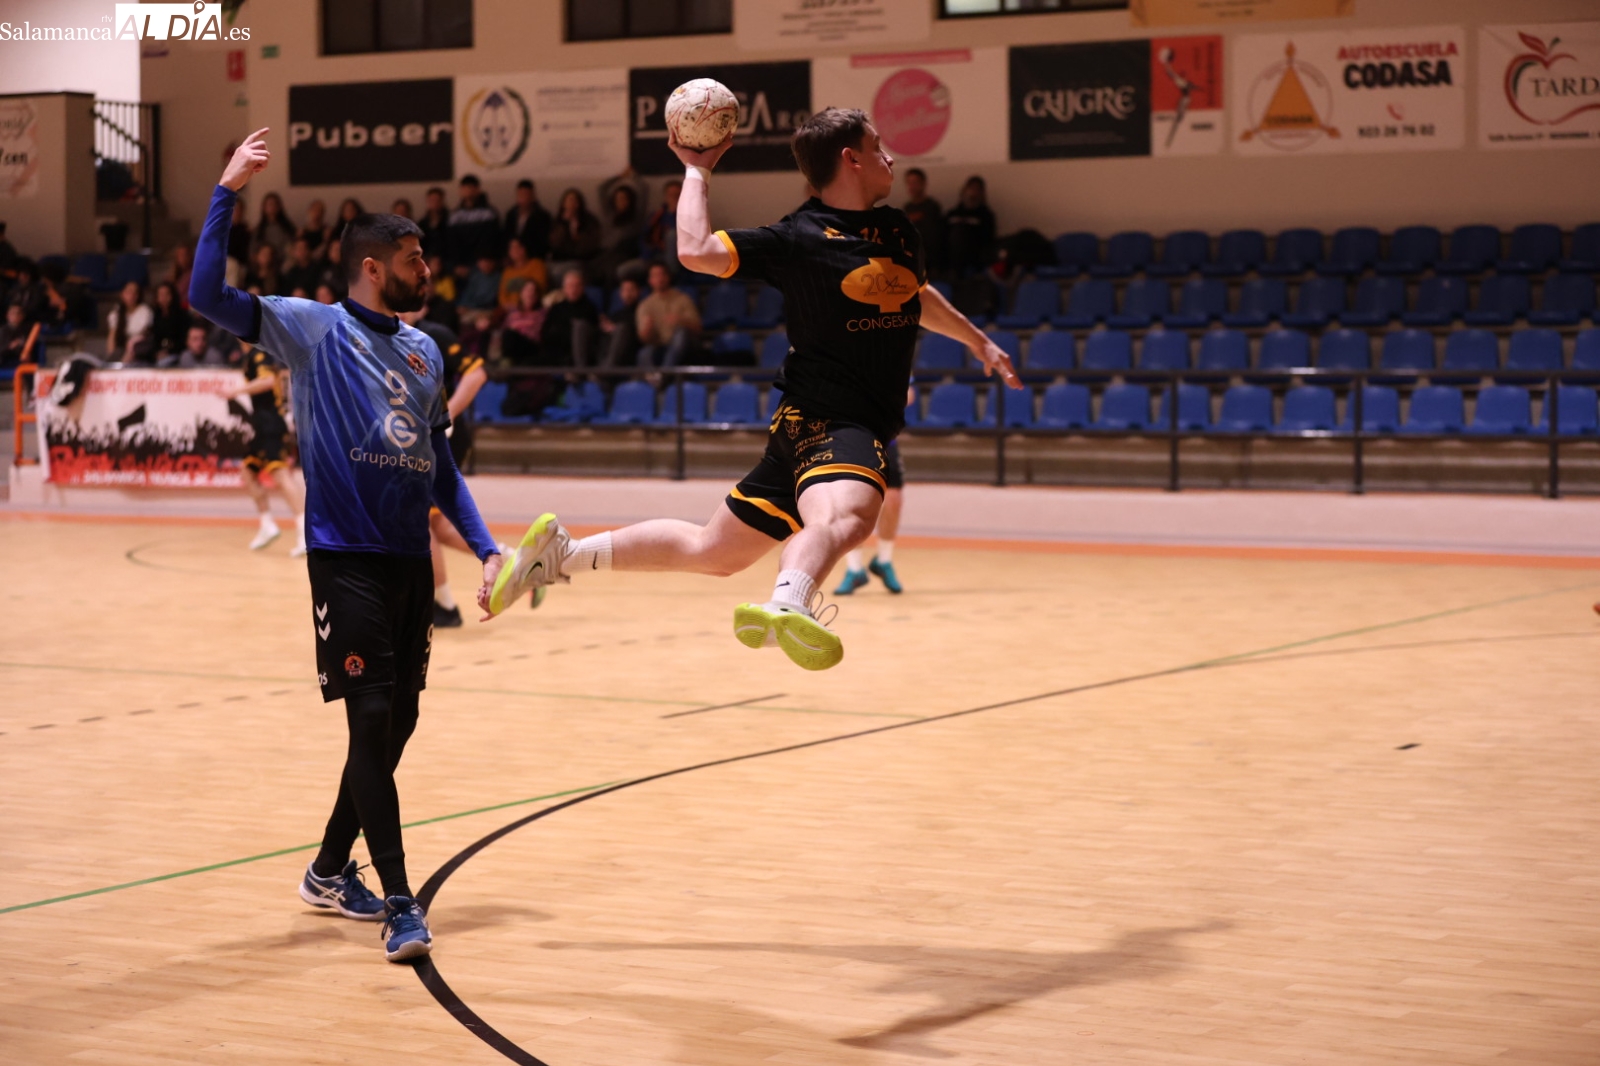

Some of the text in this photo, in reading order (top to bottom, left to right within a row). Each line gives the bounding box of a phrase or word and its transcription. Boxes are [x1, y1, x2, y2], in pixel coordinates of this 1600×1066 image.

[1336, 41, 1459, 62] AUTOESCUELA
[1343, 59, 1453, 91] CODASA
[1528, 75, 1600, 99] TARD
[384, 369, 409, 406] 9
[350, 447, 398, 469] Grupo
